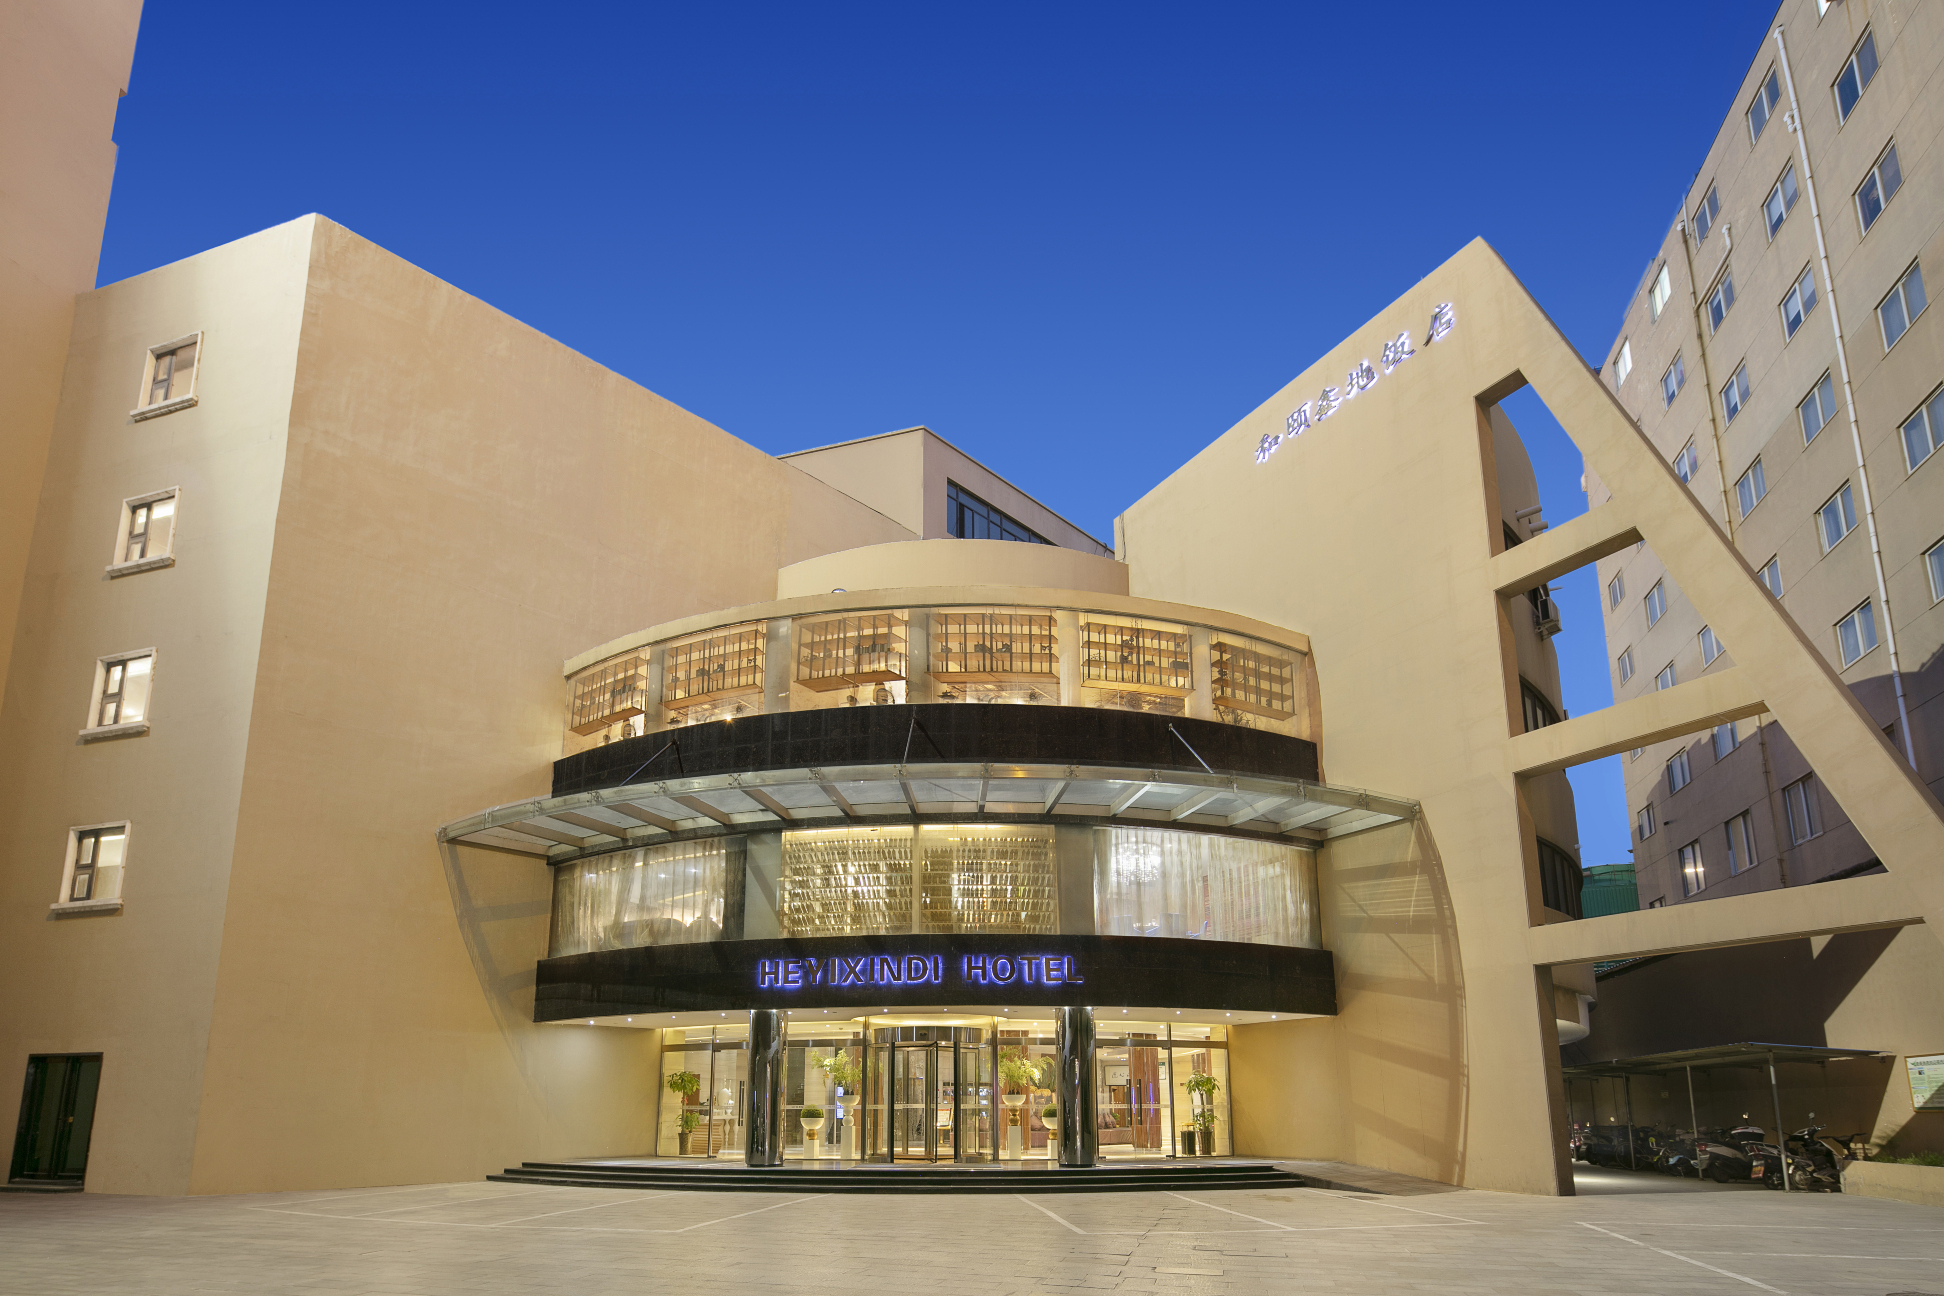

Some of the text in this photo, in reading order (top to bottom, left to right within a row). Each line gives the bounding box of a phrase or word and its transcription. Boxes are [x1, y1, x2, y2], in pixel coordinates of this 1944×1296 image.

[1255, 302, 1454, 464] 和颐鑫地饭店
[759, 955, 1084, 986] HEYIXINDI HOTEL
